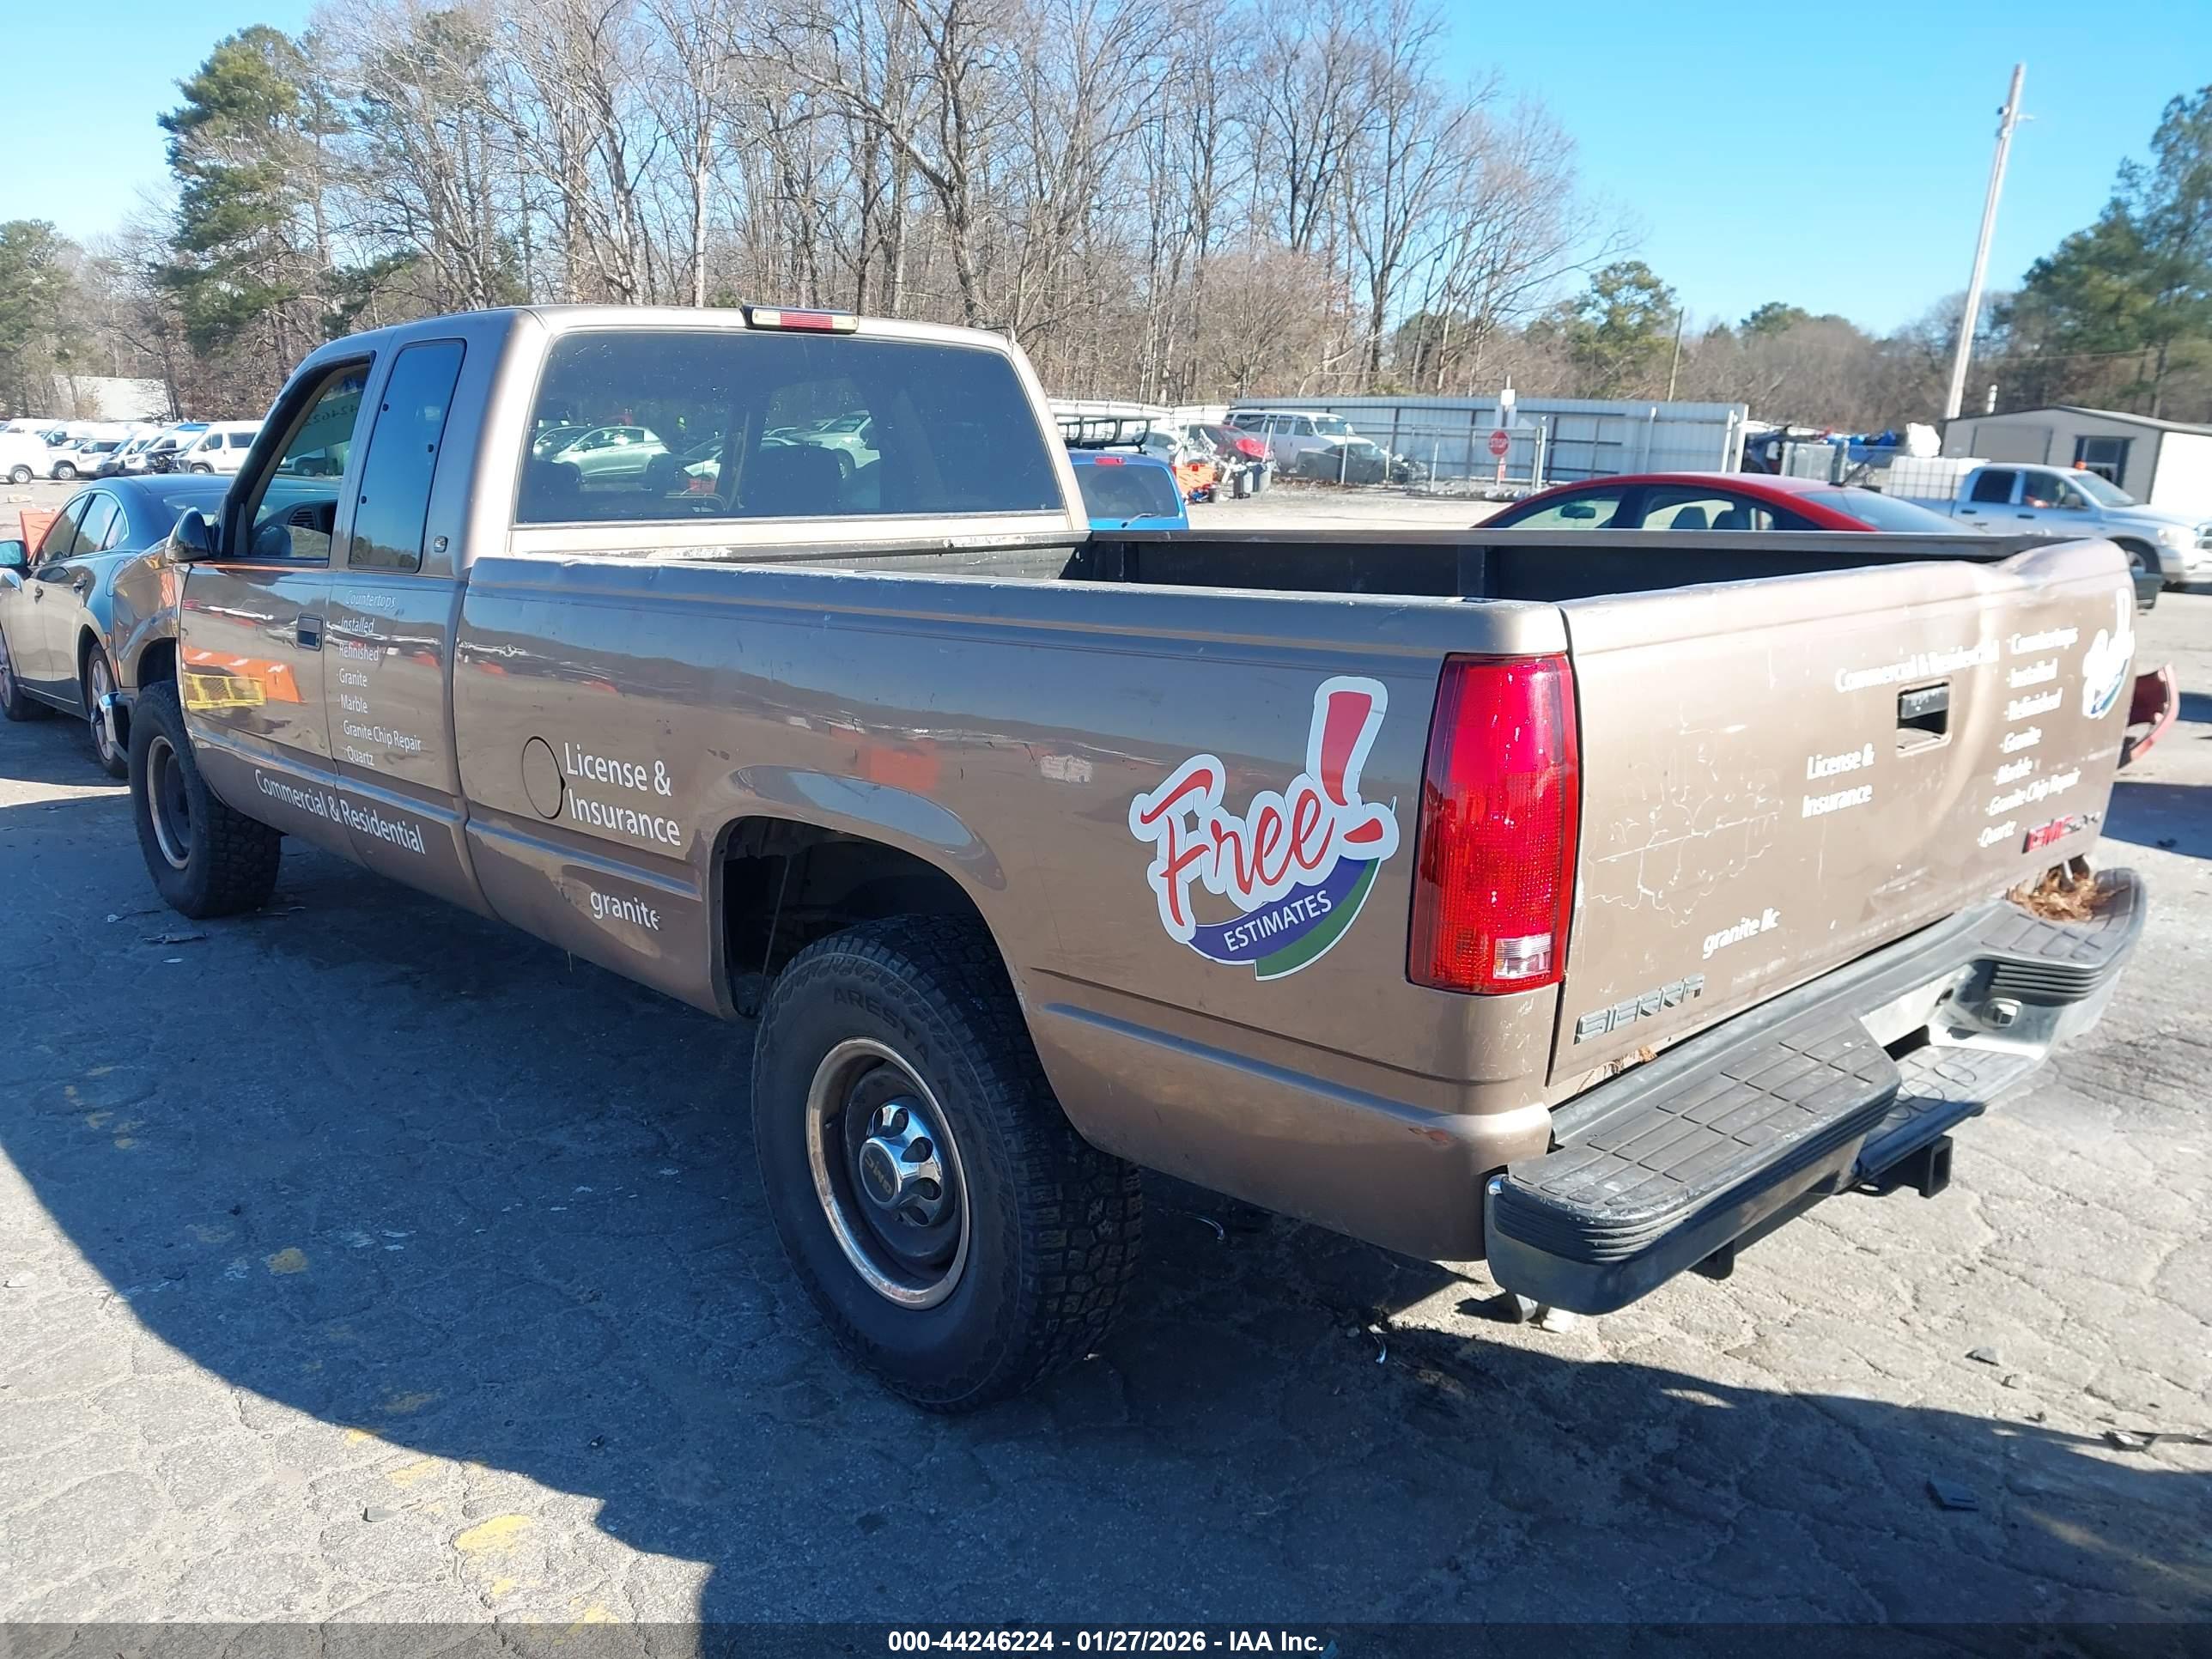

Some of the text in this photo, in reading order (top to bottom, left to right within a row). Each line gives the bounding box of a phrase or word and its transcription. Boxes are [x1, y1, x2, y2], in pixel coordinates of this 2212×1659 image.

[347, 590, 397, 611] Countertops
[341, 616, 375, 634] Installed
[339, 641, 379, 660] Refinished
[339, 668, 368, 687] Granite
[341, 694, 368, 714] Marble
[343, 720, 422, 752] Granite Chip Repair
[347, 745, 374, 766] Quartz
[564, 742, 672, 797] License &
[1807, 750, 1862, 781] License
[254, 769, 426, 854] Commercial & Residential
[568, 788, 681, 847] Insurance
[1135, 684, 1393, 933] Free!
[1802, 784, 1873, 818] Insurance
[590, 890, 660, 931] granite
[1223, 889, 1332, 952] ESTIMATES
[1703, 917, 1760, 960] granite
[1573, 972, 1705, 1045] SIERRA
